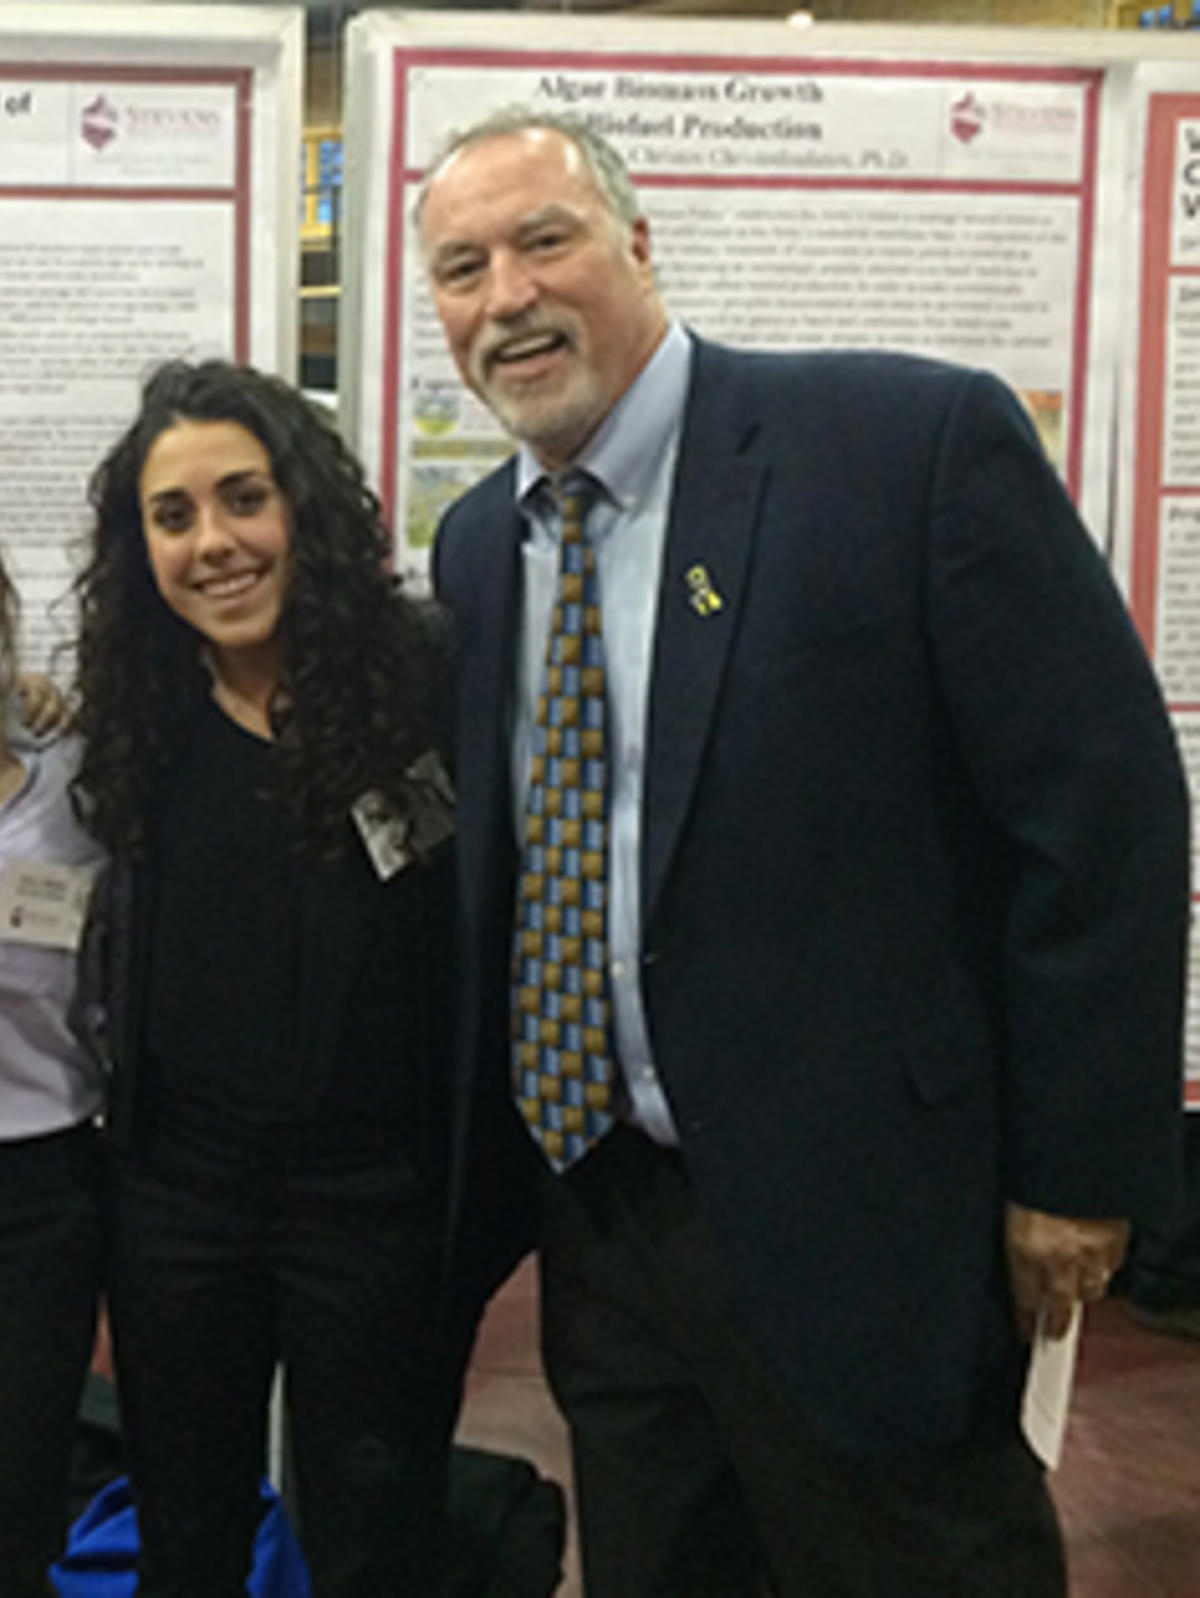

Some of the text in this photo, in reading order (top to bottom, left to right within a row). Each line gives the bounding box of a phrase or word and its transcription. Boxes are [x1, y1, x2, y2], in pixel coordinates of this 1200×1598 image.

[536, 76, 825, 103] Algae Biomass Growth
[5, 91, 33, 116] of
[683, 115, 823, 140] Production
